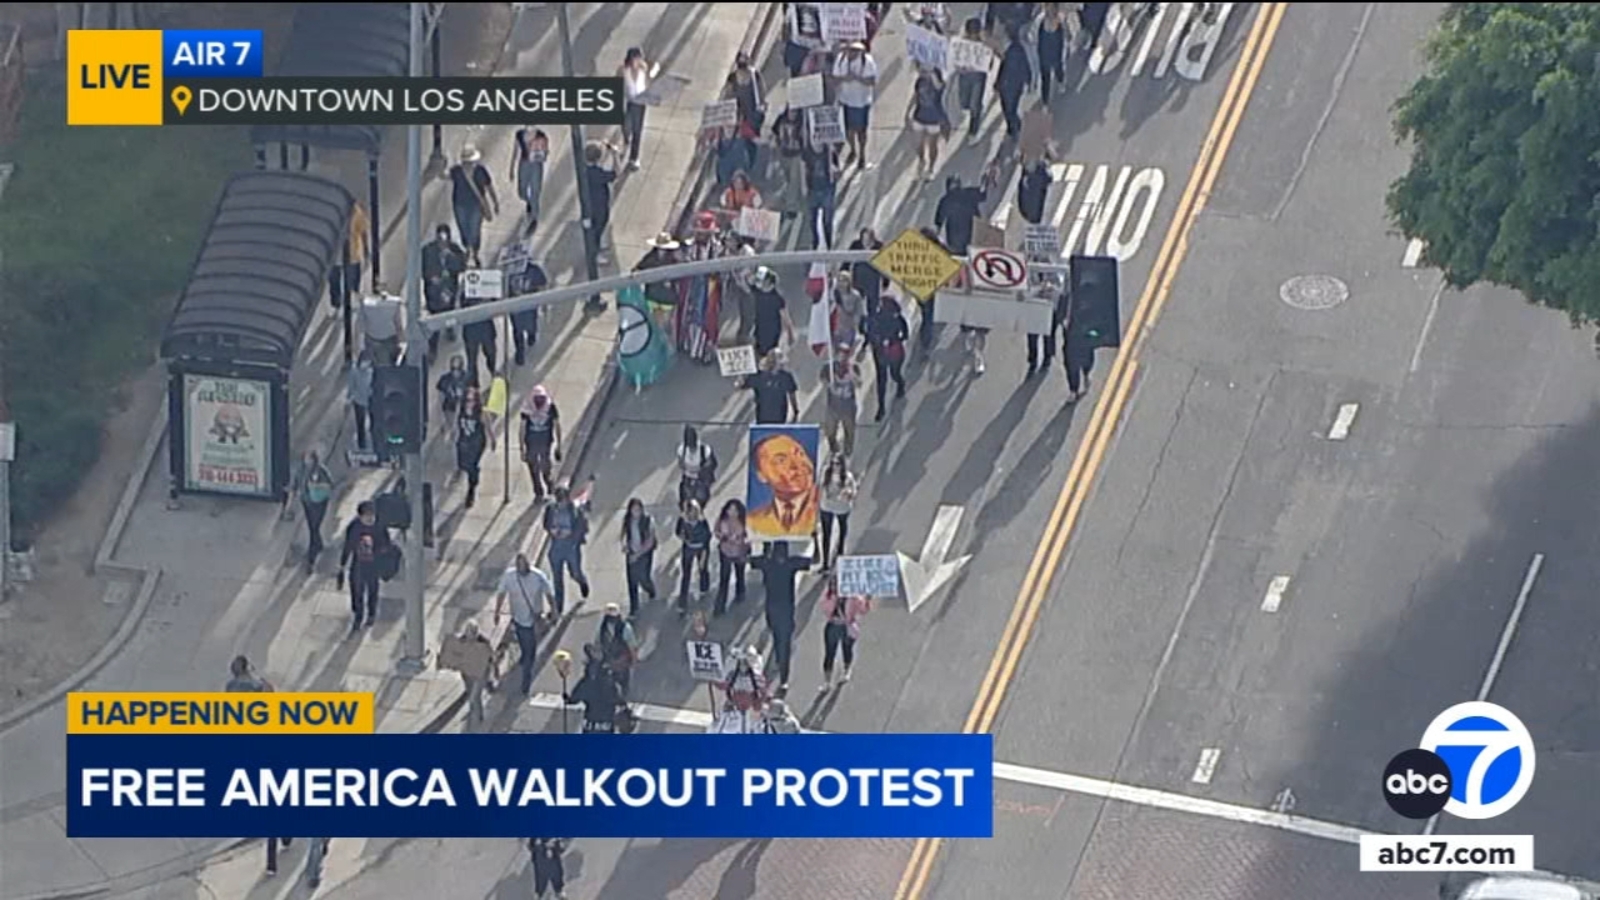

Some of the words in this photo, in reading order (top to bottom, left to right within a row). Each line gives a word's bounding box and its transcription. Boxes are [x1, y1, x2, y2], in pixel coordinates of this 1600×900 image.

[896, 240, 930, 251] THRU
[888, 252, 942, 264] TRAFFIC
[890, 265, 943, 277] MERGE
